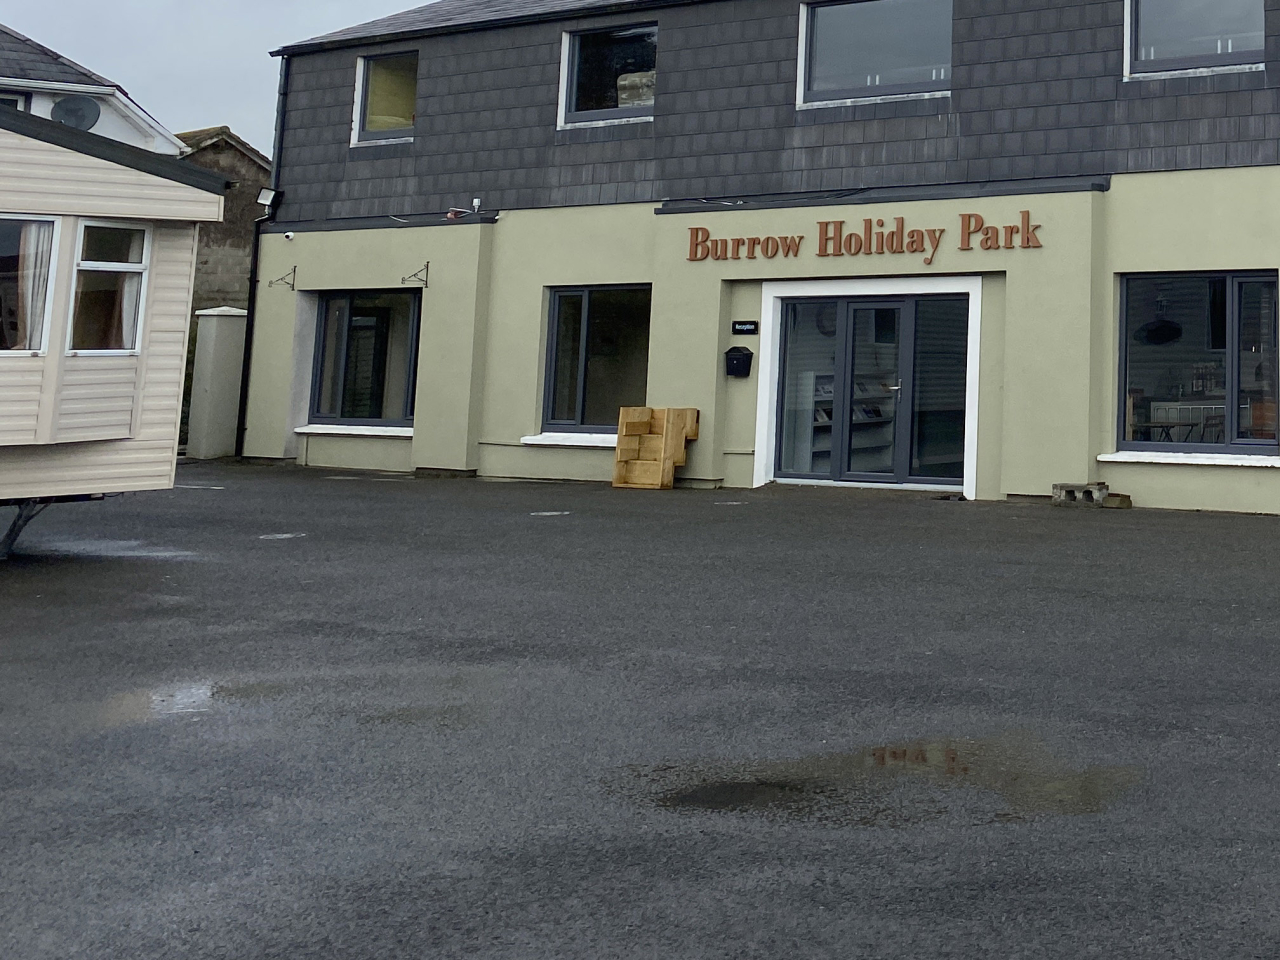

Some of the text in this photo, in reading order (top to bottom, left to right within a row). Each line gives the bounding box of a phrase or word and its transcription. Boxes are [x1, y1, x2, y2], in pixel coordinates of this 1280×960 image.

[686, 210, 1043, 265] Burrow Holiday Park
